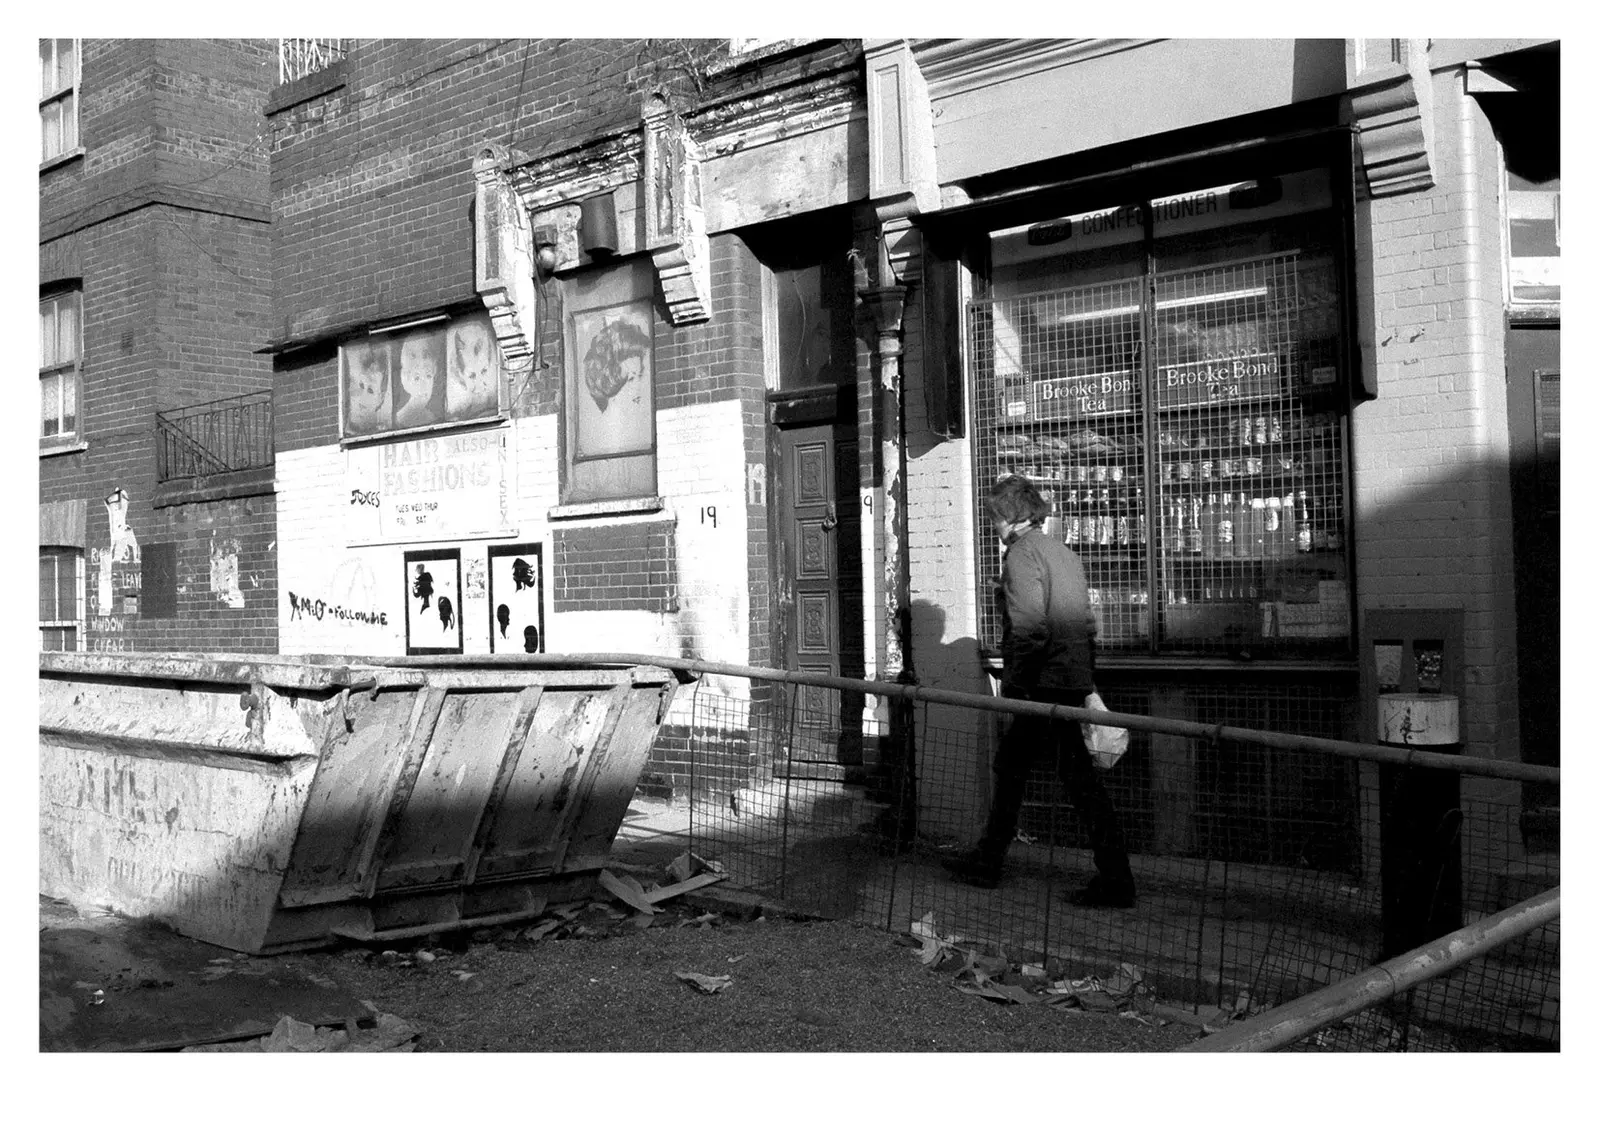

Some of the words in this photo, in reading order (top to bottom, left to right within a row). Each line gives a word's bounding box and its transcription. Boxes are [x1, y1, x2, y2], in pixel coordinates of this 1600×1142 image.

[1082, 191, 1218, 236] CONFECTIONER
[1166, 365, 1230, 387] Brooke
[1232, 357, 1278, 379] Bond
[1042, 380, 1098, 400] Brooke
[1077, 396, 1107, 412] Tea
[383, 438, 439, 468] HAIR
[383, 461, 491, 497] FASHIONS
[700, 505, 717, 529] 19
